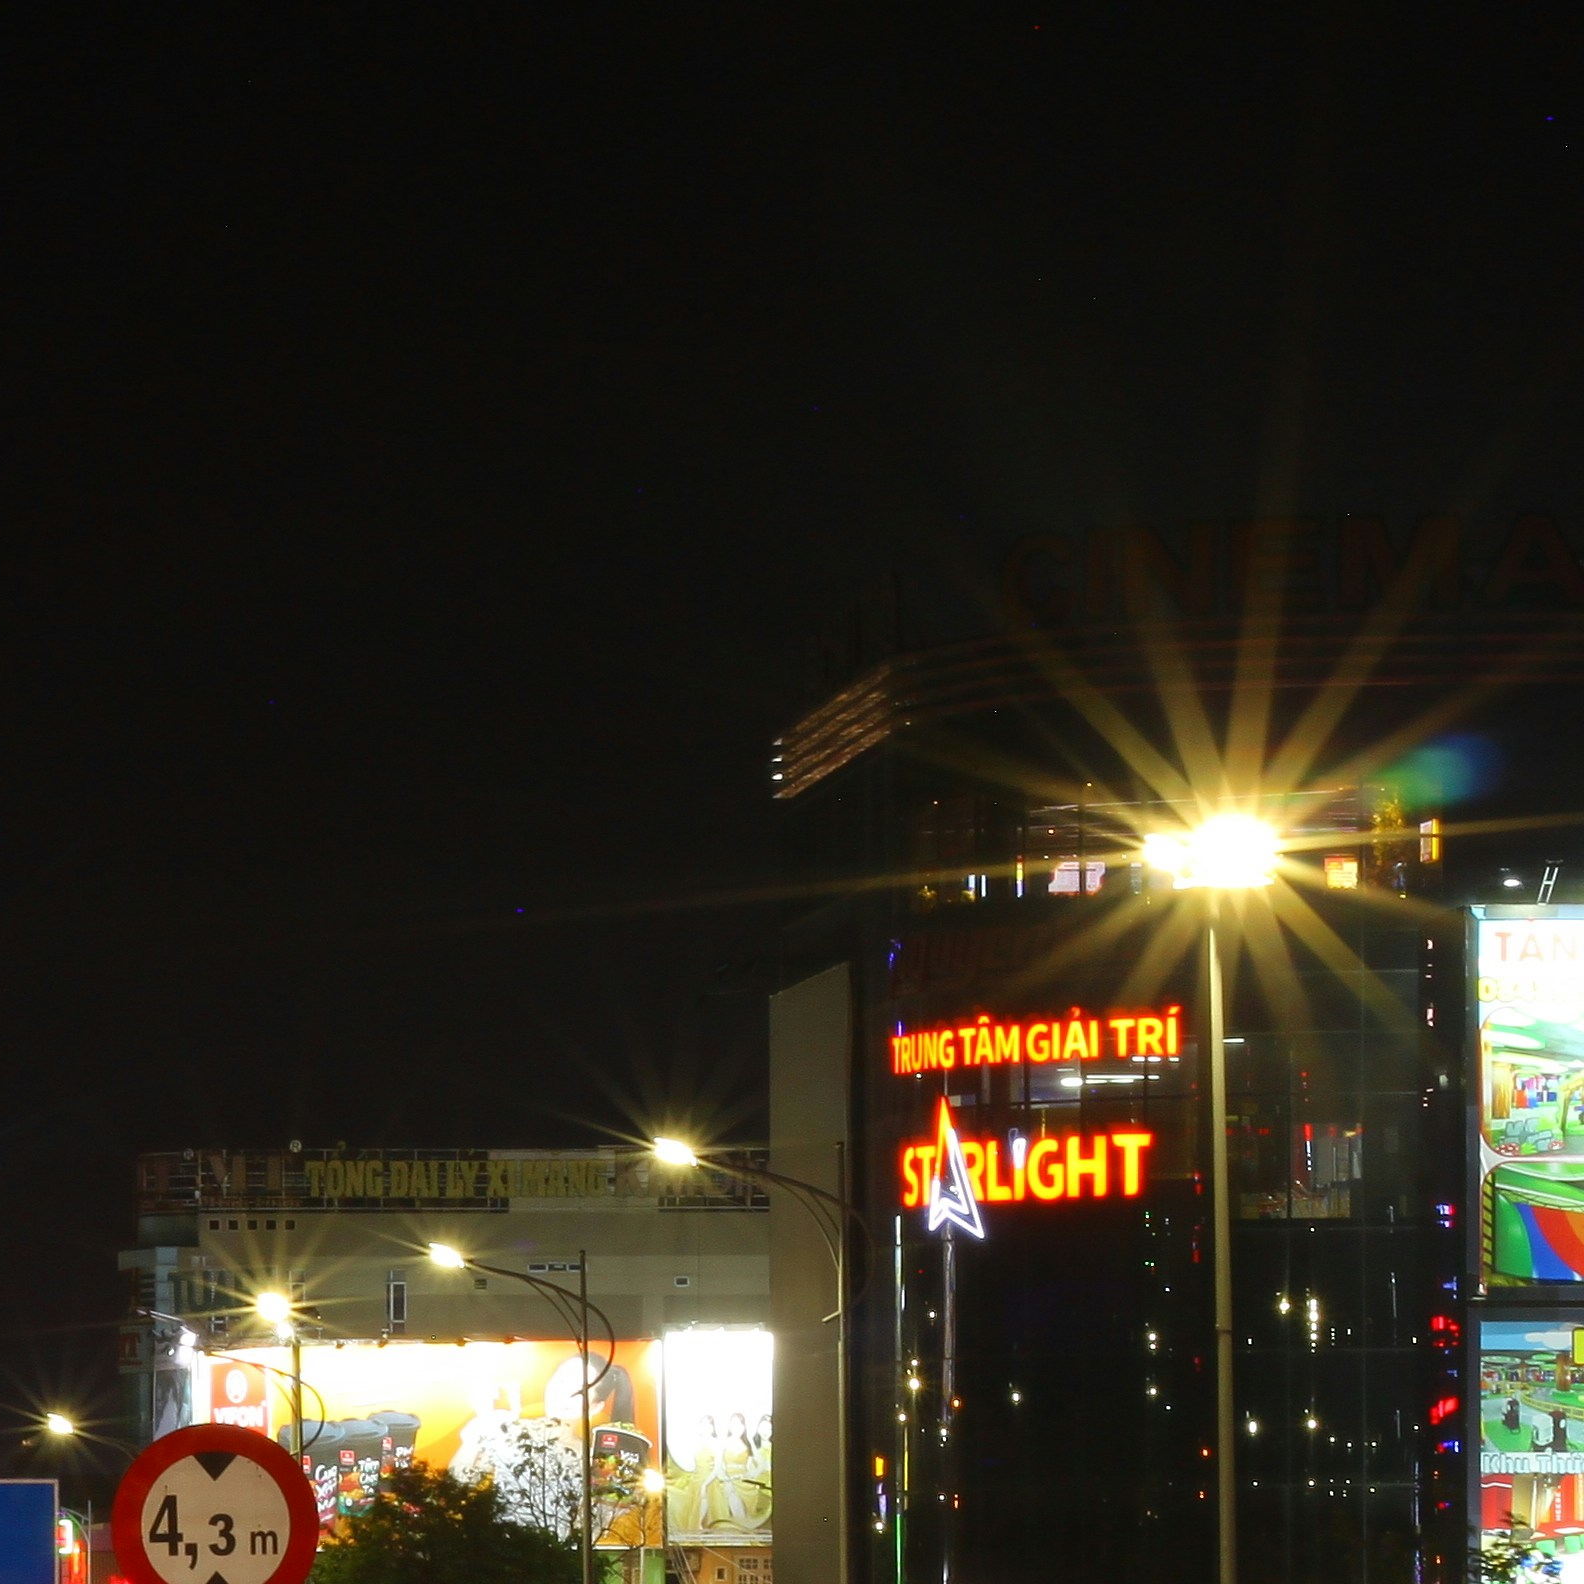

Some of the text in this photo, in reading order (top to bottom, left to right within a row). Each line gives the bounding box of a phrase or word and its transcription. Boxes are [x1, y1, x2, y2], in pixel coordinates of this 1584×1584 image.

[893, 1005, 1181, 1075] TRUNG TÂM GIẢI TRÍ
[487, 1159, 517, 1198] XI
[213, 1404, 266, 1428] VIFON
[1482, 1453, 1530, 1475] Khu
[149, 1494, 279, 1571] 4,3 m
